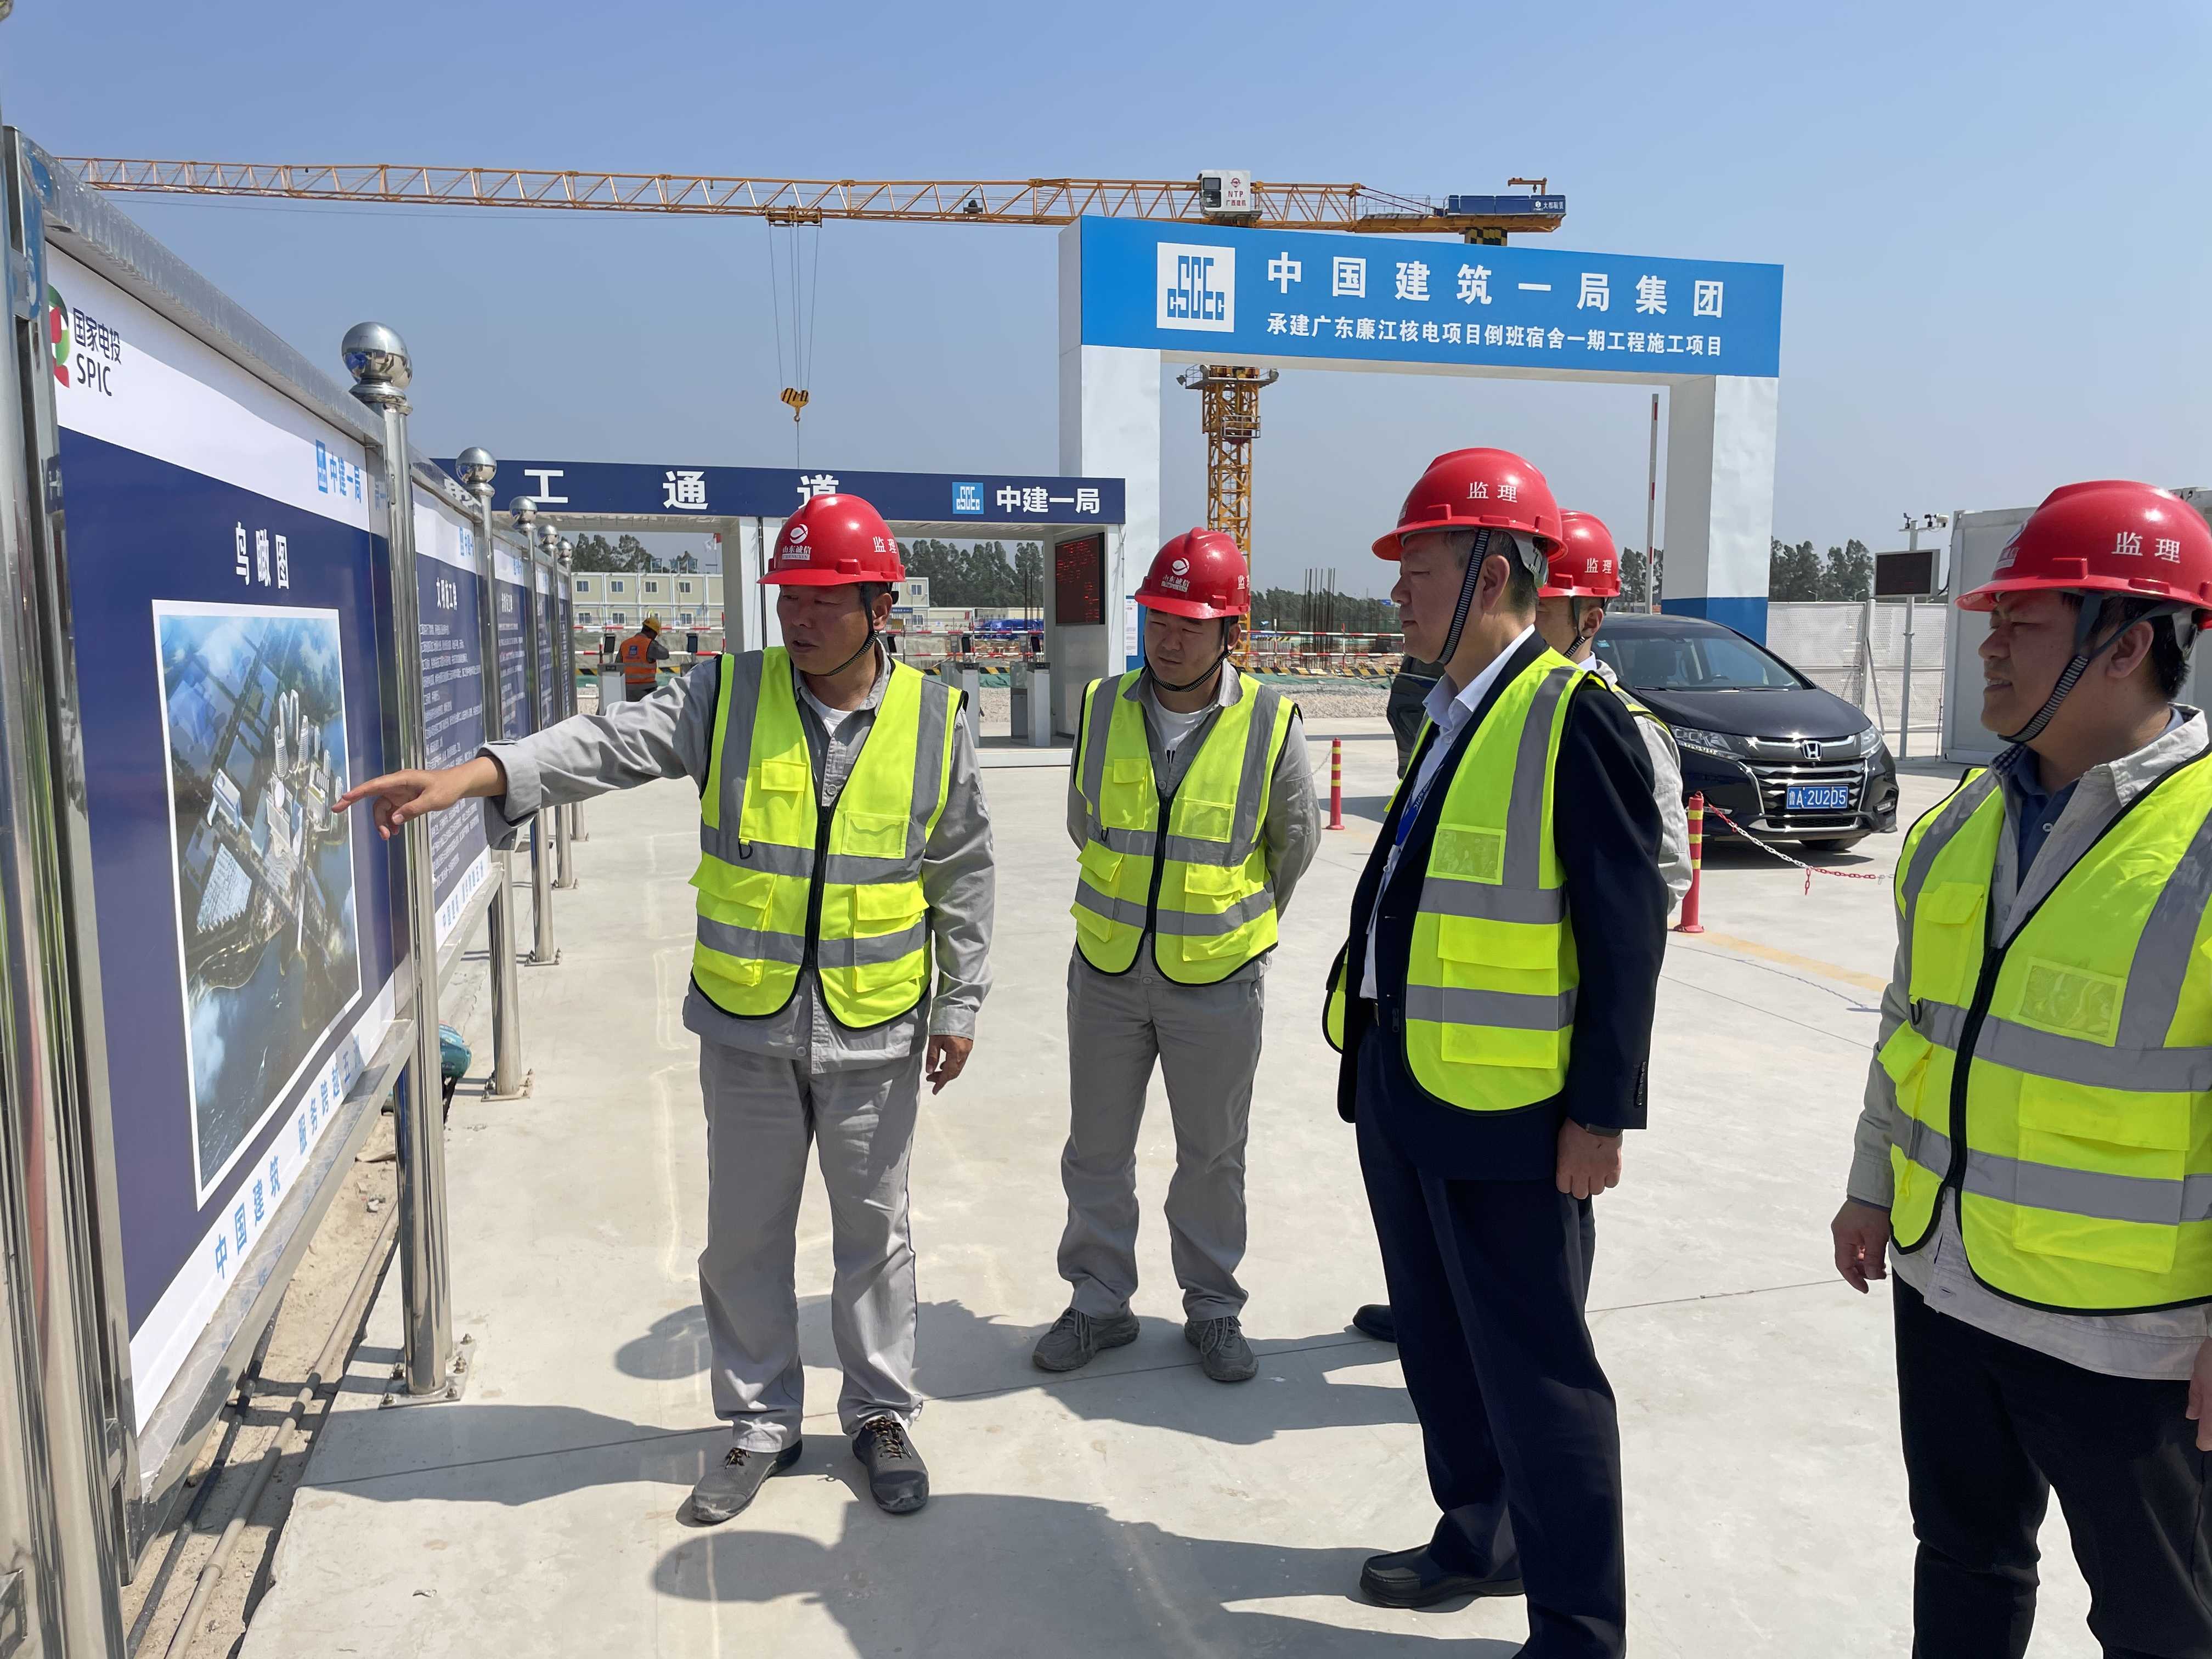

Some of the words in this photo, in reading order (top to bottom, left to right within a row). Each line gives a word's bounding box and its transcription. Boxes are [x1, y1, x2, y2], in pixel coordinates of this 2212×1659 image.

[1267, 251, 1724, 318] 中国建筑一局集团
[72, 307, 122, 365] 国家电投
[1266, 312, 1722, 357] 承建广东廉江核电项目倒班宿舍一期工程施工项目
[76, 353, 112, 397] SPIC
[330, 451, 362, 504] 中建一局
[1466, 481, 1518, 503] 监理
[996, 486, 1101, 514] 中建一局
[234, 521, 290, 590] 鸟瞰图
[873, 536, 897, 554] 监理
[1584, 558, 1612, 574] 监理
[2111, 531, 2181, 564] 监理
[215, 1155, 281, 1279] 中国建筑
